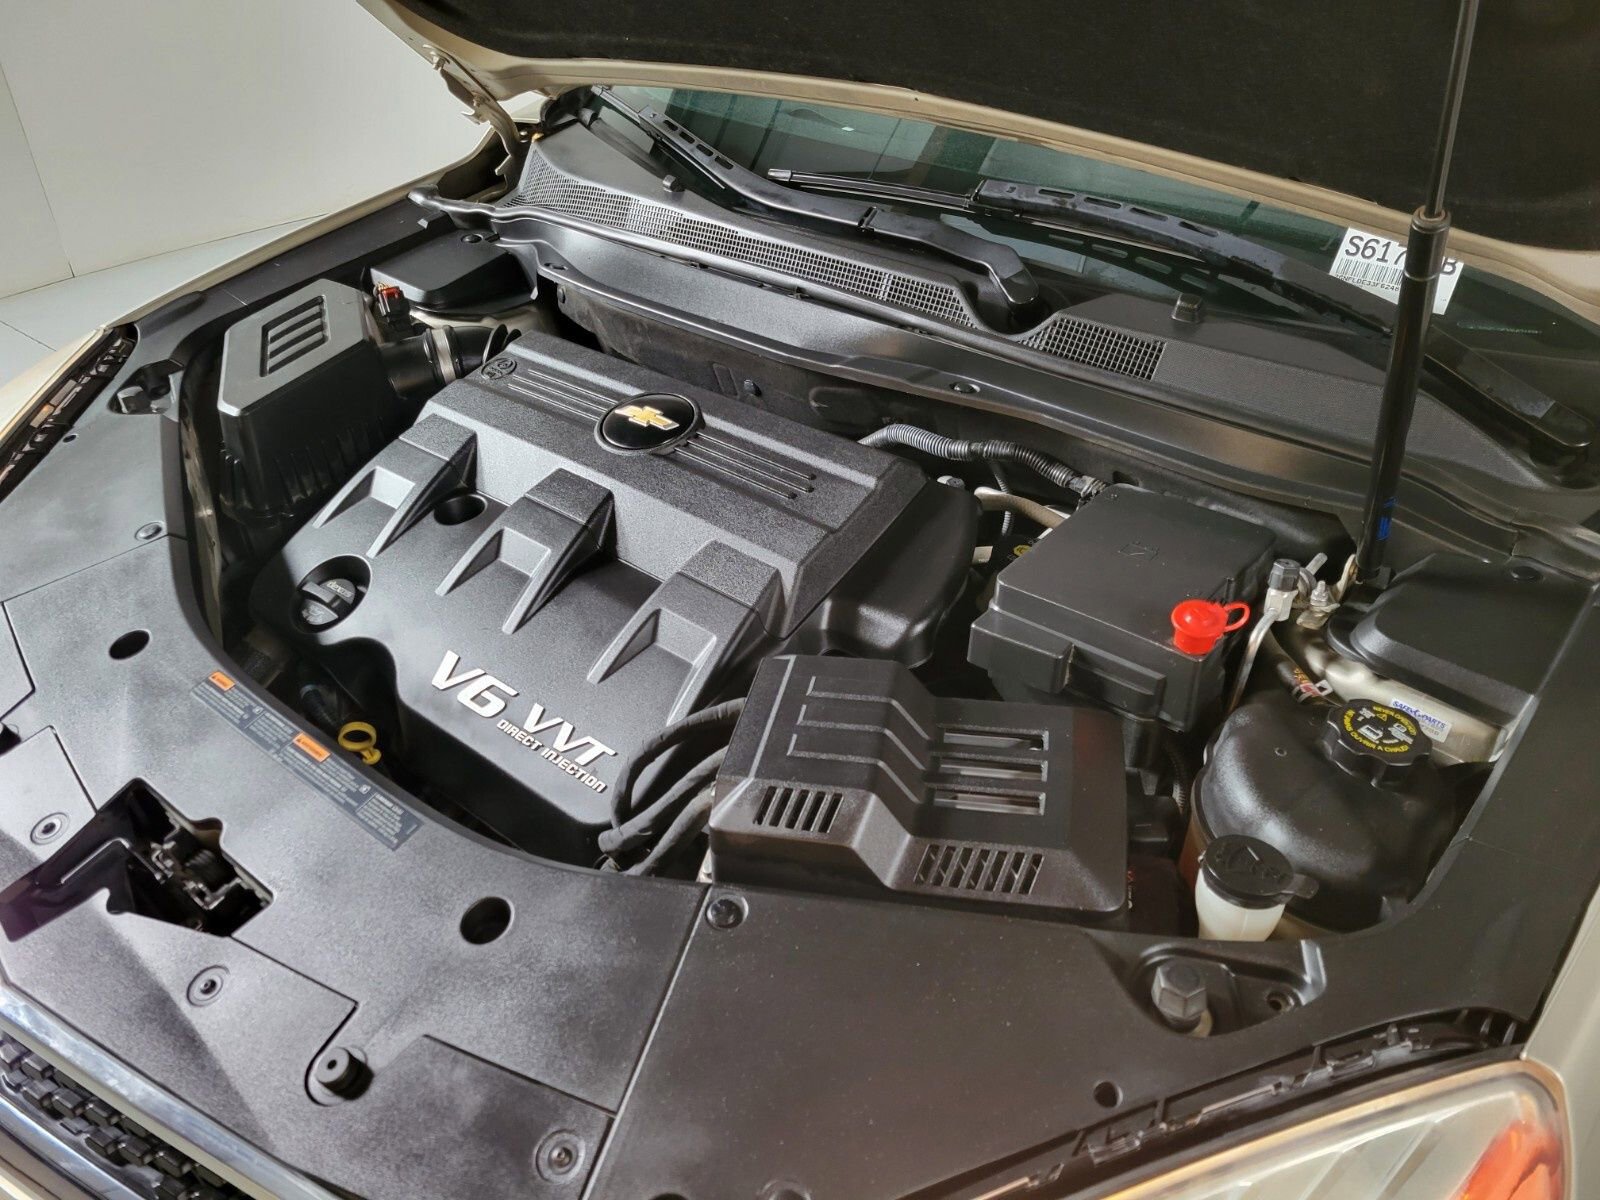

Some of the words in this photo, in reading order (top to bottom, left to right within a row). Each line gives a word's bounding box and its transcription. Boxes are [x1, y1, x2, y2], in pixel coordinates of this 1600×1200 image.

[1345, 235, 1457, 276] S617B
[431, 650, 519, 718] V6
[523, 702, 617, 767] VVT
[497, 718, 544, 751] DIRECT
[540, 747, 607, 793] INJECTION
